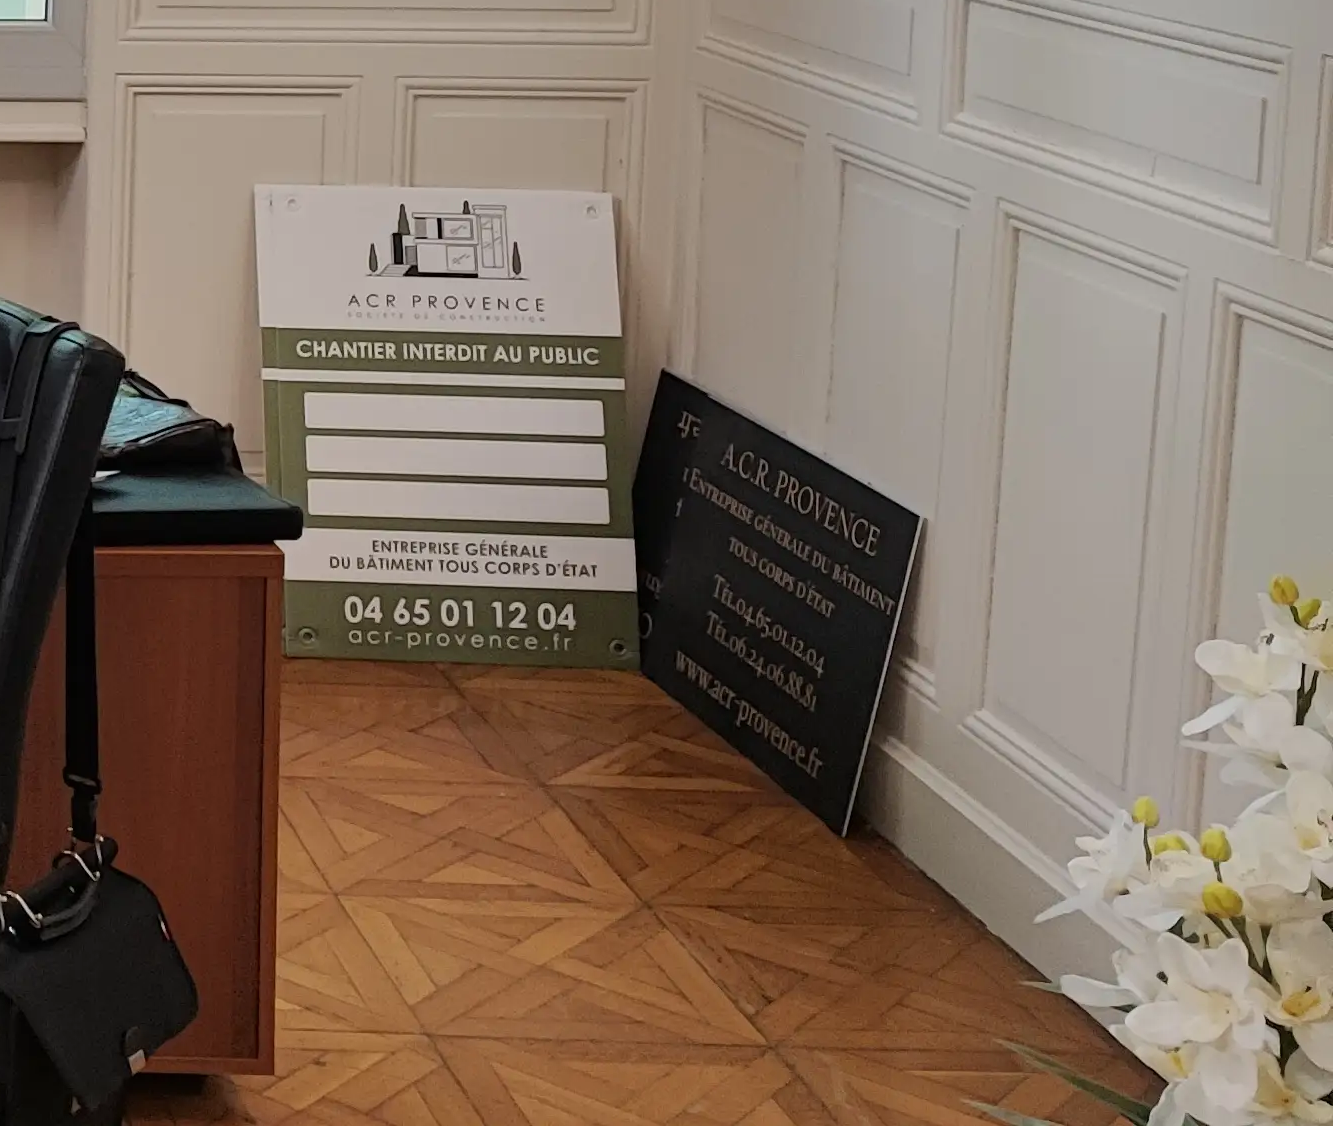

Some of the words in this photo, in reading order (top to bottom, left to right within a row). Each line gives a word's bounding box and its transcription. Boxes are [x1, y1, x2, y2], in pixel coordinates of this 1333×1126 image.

[348, 293, 396, 308] ACR
[412, 294, 545, 312] PROVENCE
[296, 339, 396, 360] CHANTIER
[403, 343, 487, 362] INTERDIT
[493, 345, 522, 363] AU
[530, 346, 599, 365] PUBLIC
[774, 470, 881, 557] PROVENCE
[372, 540, 460, 557] ENTREPRISE
[465, 539, 548, 559] GÉNÉRALE
[329, 556, 351, 570] DU
[356, 555, 434, 572] BÂTIMENT
[438, 560, 479, 574] TOUS
[484, 561, 540, 576] CORPS
[545, 560, 598, 578] D'ÉTAT
[728, 536, 758, 568] TOUS
[758, 558, 795, 593] CORPS
[812, 550, 832, 574] DU
[344, 595, 383, 624] 04
[393, 597, 431, 626] 65
[440, 599, 474, 627] 01
[491, 601, 527, 629] 12
[537, 602, 576, 631] 04
[348, 628, 572, 651] acr-provence.fr
[675, 650, 824, 779] www.acr-provence.fr
